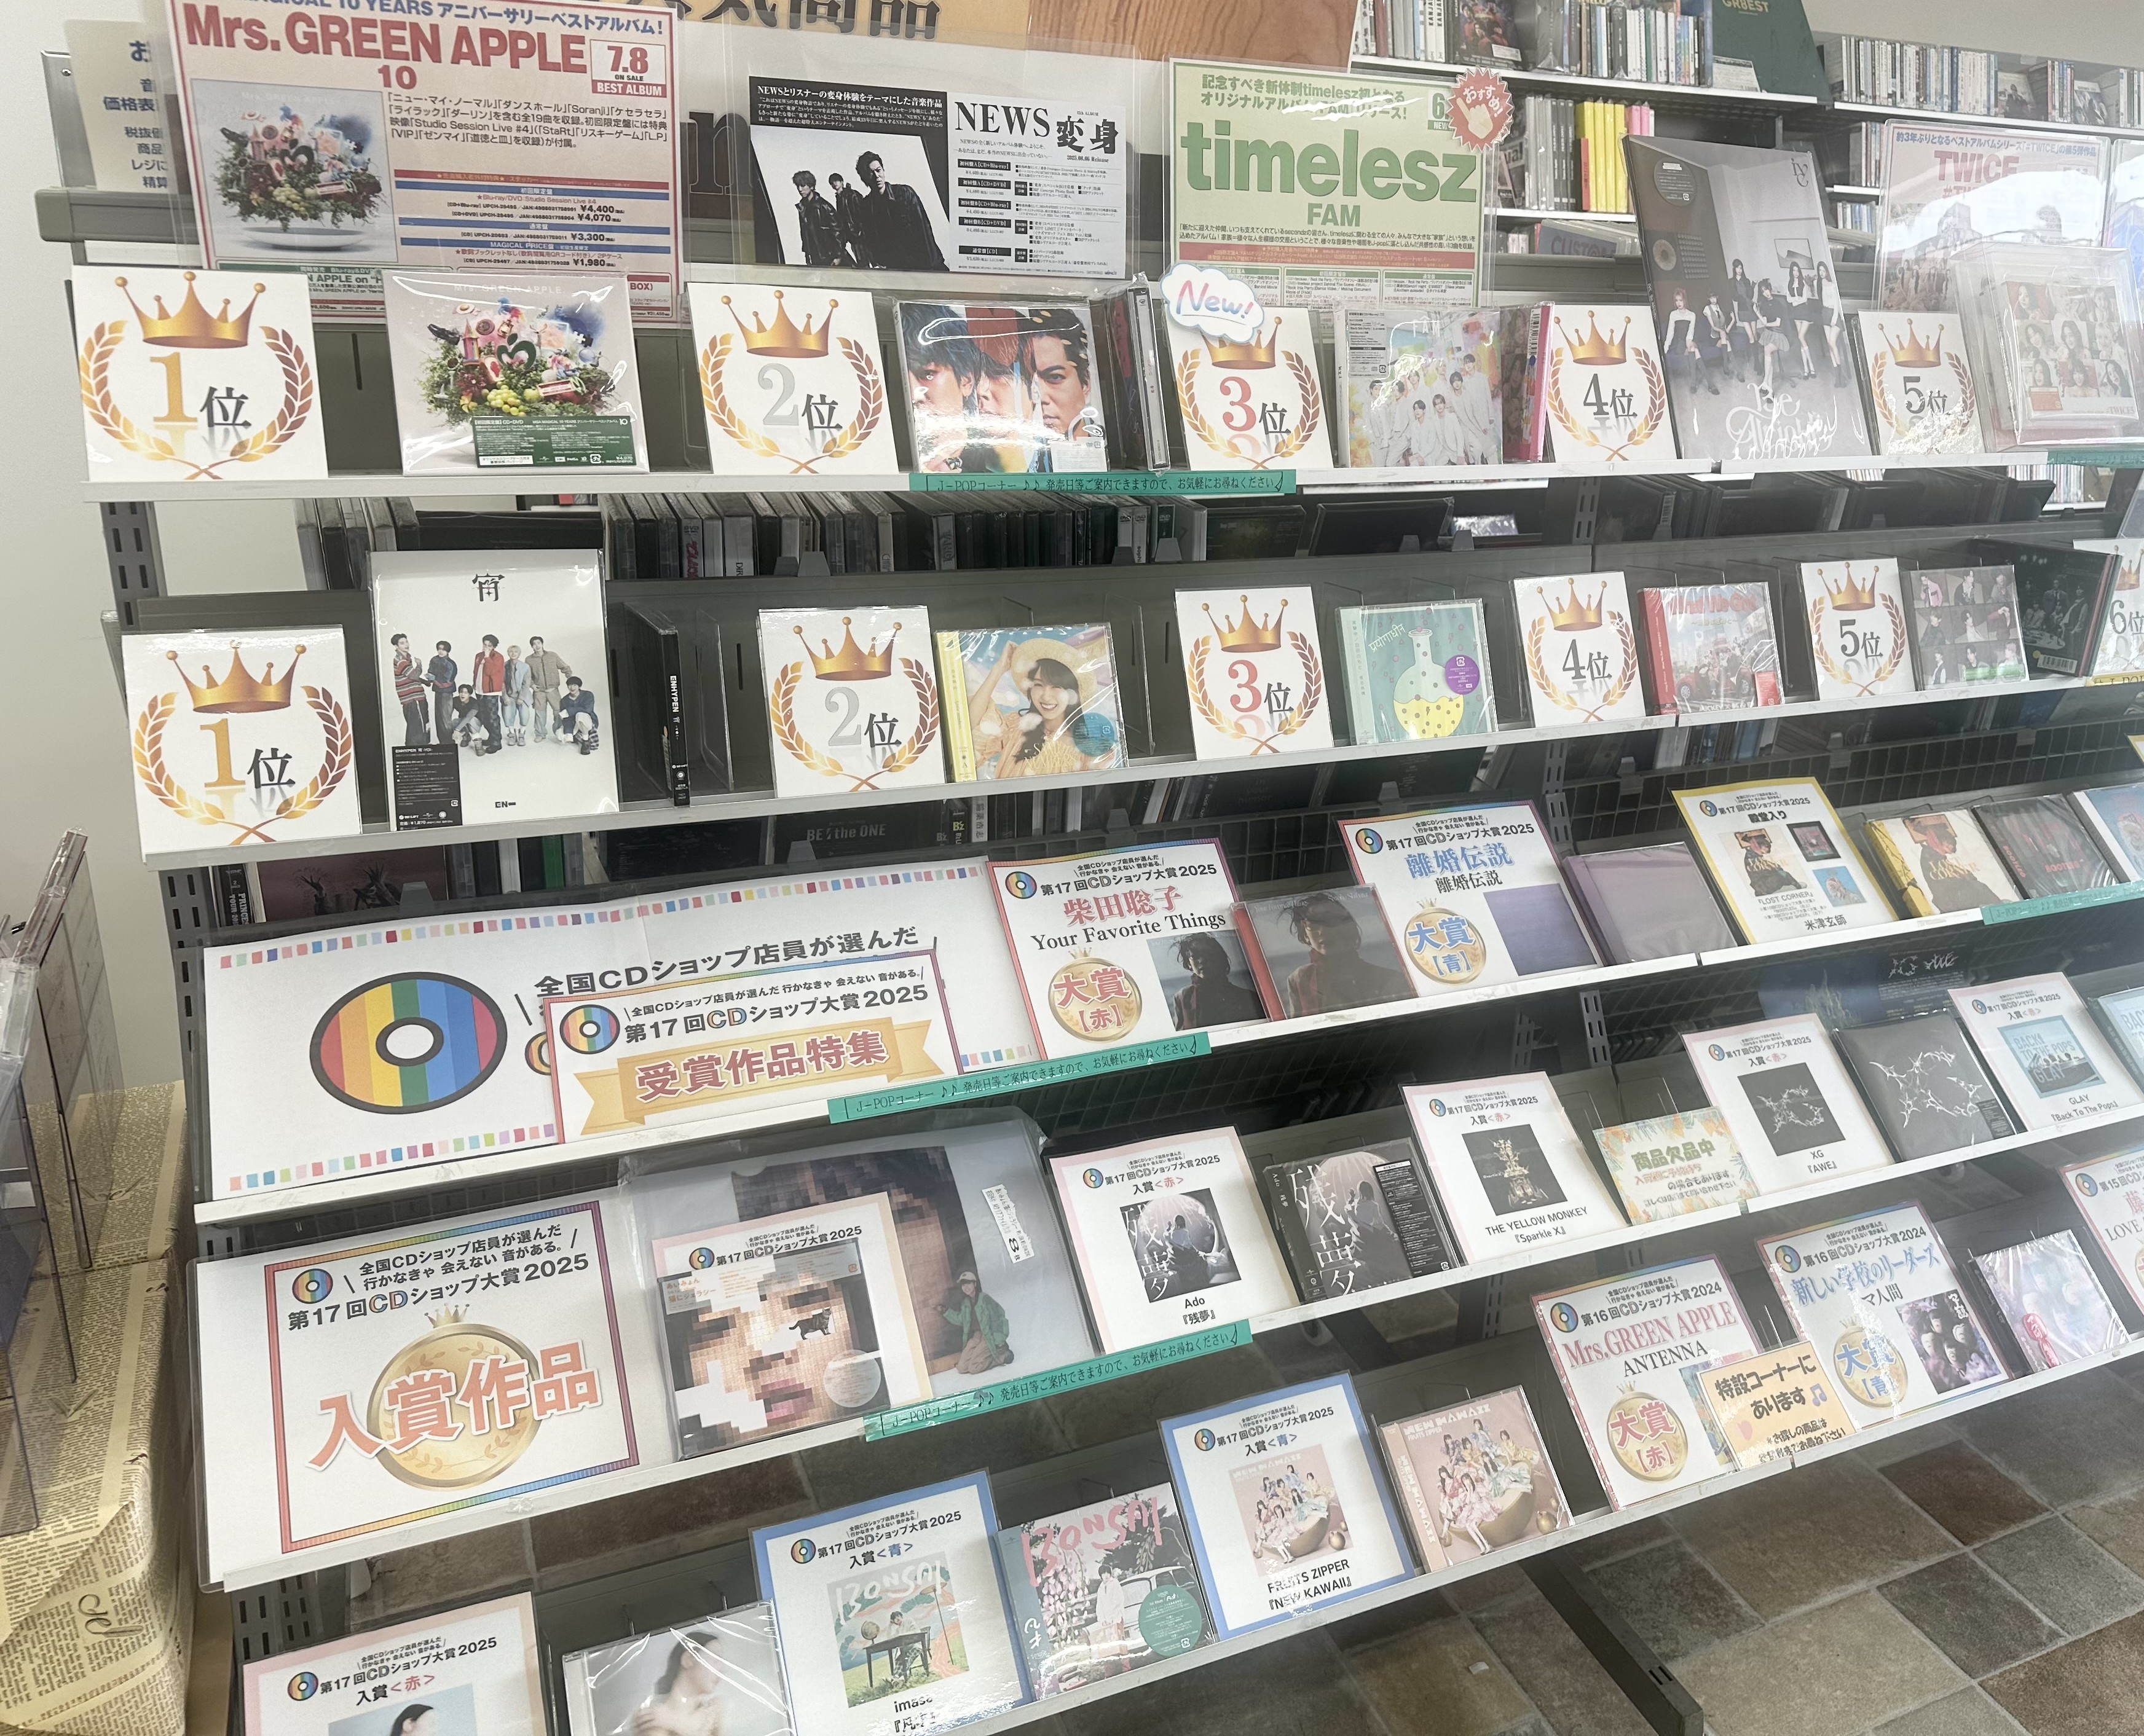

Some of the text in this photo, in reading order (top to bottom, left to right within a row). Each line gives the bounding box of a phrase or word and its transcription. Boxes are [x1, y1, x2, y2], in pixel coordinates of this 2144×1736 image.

[362, 0, 663, 34] YEARS アニバーサリーベストアルバム!
[451, 25, 587, 74] APPLE
[607, 45, 648, 74] 7.8
[377, 65, 417, 90] 10
[597, 82, 662, 96] BEST ALBUM
[103, 96, 156, 112] 価格表
[1462, 83, 1504, 119] おすすめ!
[450, 120, 490, 131] Session
[492, 123, 513, 132] Live
[955, 101, 1050, 137] NEWS
[1056, 115, 1119, 154] 変身
[132, 159, 167, 171] レジに
[138, 143, 163, 155] 商品
[1180, 119, 1476, 203] timelesz
[1934, 150, 2019, 184] TWICE
[578, 213, 611, 222] ¥4,070
[580, 205, 615, 214] ¥4,400
[1307, 203, 1360, 227] FAM
[571, 233, 605, 242] ¥3,300
[573, 258, 605, 267] ¥1,980
[1176, 281, 1253, 320] New!
[149, 352, 249, 430] 1位
[757, 363, 843, 431] 2位
[1219, 375, 1291, 437] 3位
[1583, 373, 1637, 418] 4位
[1903, 376, 1947, 414] 5位
[1839, 619, 1883, 658] 5位
[1562, 638, 1612, 680] 4位
[670, 675, 679, 713] ENHYPEN
[1228, 660, 1294, 713] 3位
[824, 686, 902, 748] 2位
[199, 718, 296, 789] 1位
[860, 824, 886, 837] ONE
[953, 821, 964, 831] B'z
[1748, 811, 1787, 823] 殿堂入り
[1078, 854, 1159, 871] 全国CDショップ店員が選んだ
[1404, 842, 1514, 880] 離婚伝説
[1435, 870, 1503, 894] 離婚伝説
[1063, 886, 1182, 927] 柴田聡子
[1805, 916, 1847, 931] 米津玄師
[1031, 913, 1226, 950] Your Favorite Things
[1407, 917, 1475, 954] 大賞
[534, 926, 919, 997] 全国CDショップ店員が選んだ
[1431, 951, 1474, 976] 【青】
[631, 969, 921, 1017] 全国CDショップ店員が選んだ 行かなきゃ 会えない 音がある。
[1052, 967, 1131, 1008] 大賞
[1079, 1004, 1123, 1033] 【赤】
[637, 1031, 889, 1102] 受賞作品特集
[2035, 1065, 2065, 1083] GLAY
[2069, 1094, 2089, 1105] GLAY
[2072, 1106, 2099, 1118] To The
[1631, 1138, 1716, 1172] 商品欠品中
[1810, 1150, 1824, 1160] XG
[1287, 1164, 1362, 1296] 残夢
[1485, 1206, 1588, 1236] THE YELLOW MONKEY
[2105, 1219, 2142, 1241] LOVE
[359, 1223, 562, 1276] 全国CDショップ店員が選んだ
[364, 1241, 562, 1290] 行かなきゃ 会えない 音がある。
[1791, 1243, 1941, 1307] 新しい学校のリーダーズ
[1184, 1296, 1206, 1310] Ado
[1861, 1283, 1903, 1307] マ人間
[1182, 1310, 1216, 1325] 『残夢』
[1677, 1301, 1736, 1337] APPLE
[1624, 1340, 1709, 1377] ANTENNA
[1836, 1334, 1896, 1377] 大賞
[1714, 1353, 1817, 1400] 特設コーナーに
[306, 1338, 602, 1471] 入賞作品
[1751, 1388, 1808, 1419] あります
[1404, 1420, 1434, 1436] NEW
[1609, 1400, 1677, 1448] 大賞
[1638, 1442, 1675, 1473] 【赤】
[1021, 1497, 1162, 1587] BONSAI
[1312, 1558, 1350, 1580] ZIPPER
[835, 1560, 942, 1624] BONSAI
[1304, 1576, 1352, 1599] KAWAII』
